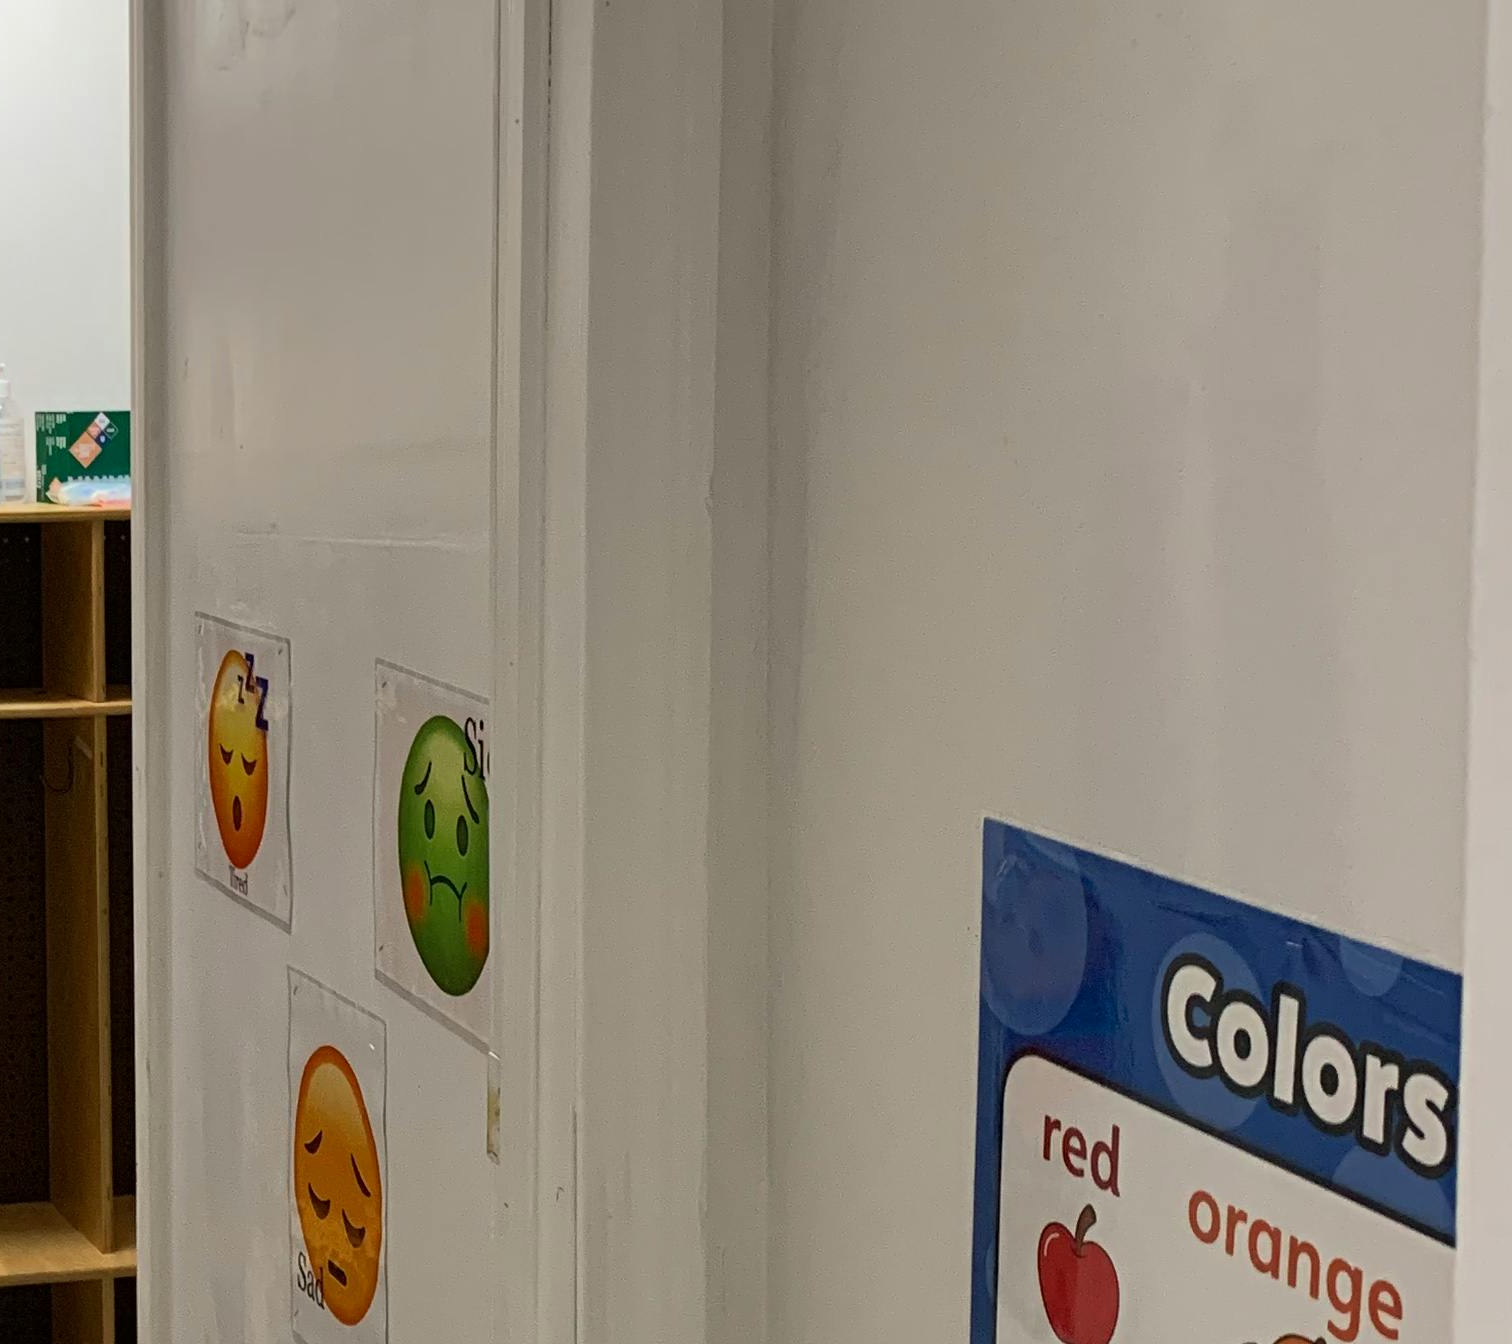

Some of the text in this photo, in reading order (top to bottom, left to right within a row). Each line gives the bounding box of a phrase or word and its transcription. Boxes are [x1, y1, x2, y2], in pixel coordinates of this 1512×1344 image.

[464, 717, 490, 781] Si
[1161, 953, 1455, 1175] Colors
[1042, 1113, 1121, 1199] red
[297, 1251, 325, 1311] Sad
[1187, 1190, 1404, 1343] orange
